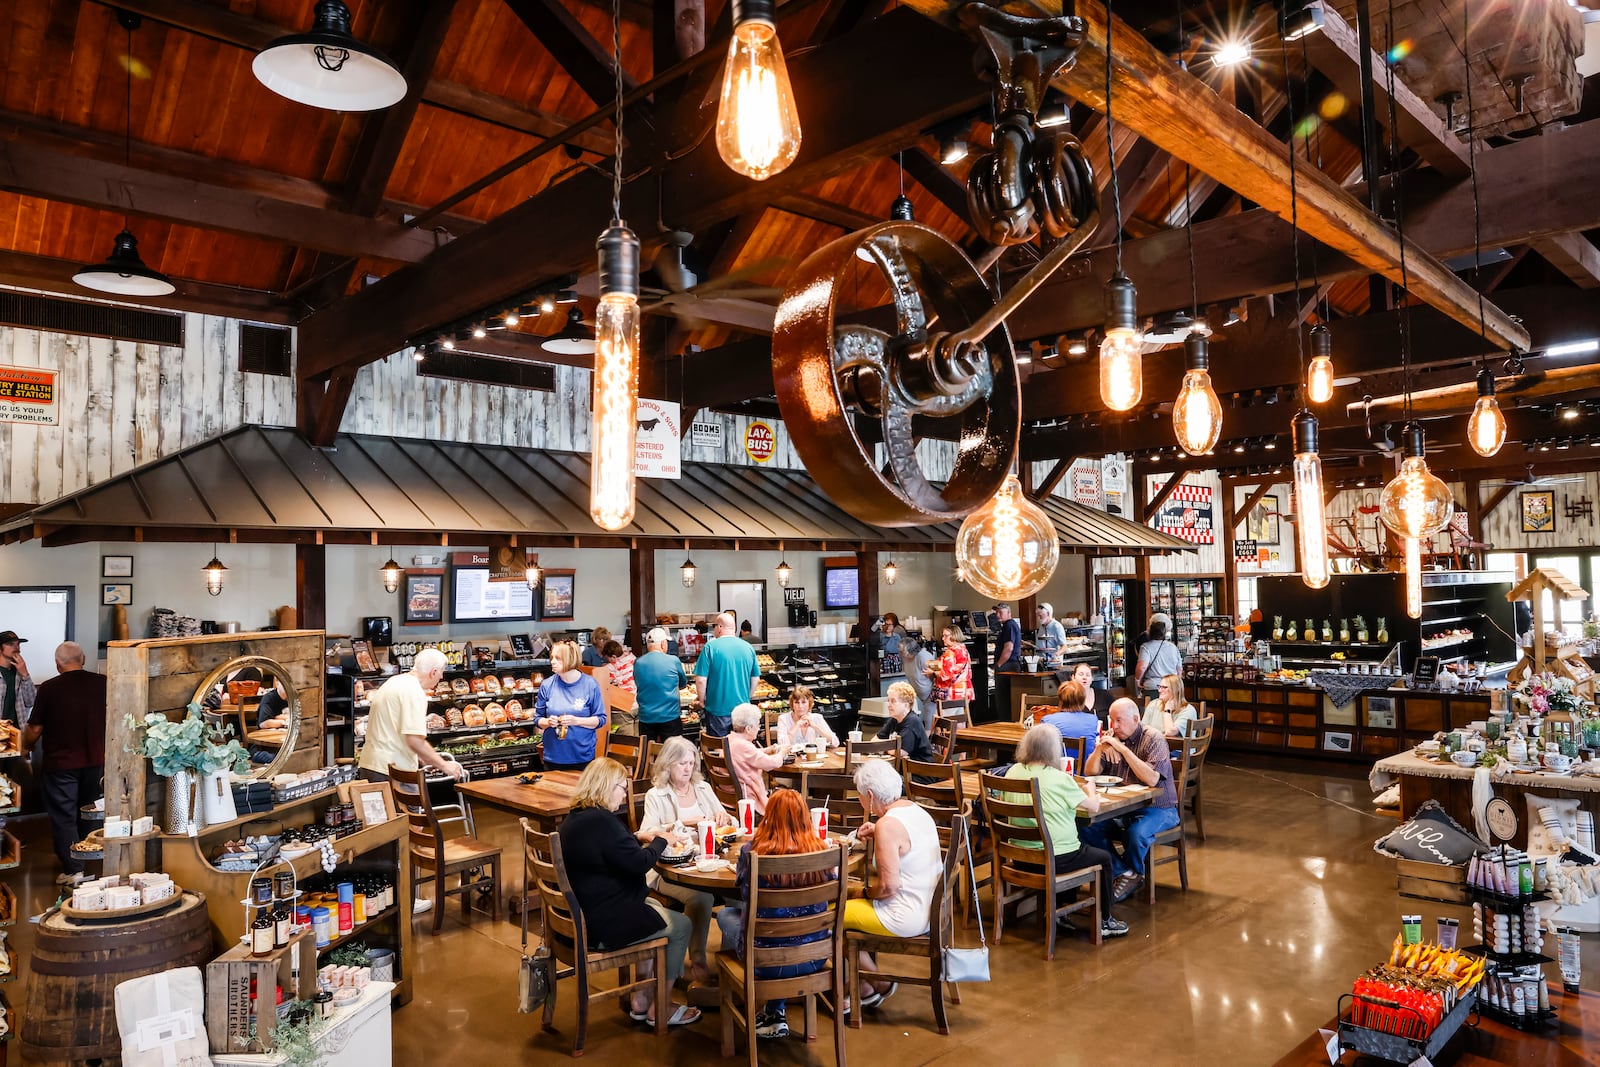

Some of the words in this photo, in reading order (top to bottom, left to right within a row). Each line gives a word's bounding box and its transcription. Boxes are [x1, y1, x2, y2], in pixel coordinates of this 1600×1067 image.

[17, 383, 51, 392] HEALTH
[15, 390, 51, 399] STATION
[12, 414, 53, 422] PROBLEMS
[665, 416, 679, 437] SONS
[693, 423, 720, 434] BOOMS
[748, 428, 766, 438] LAY
[747, 438, 774, 451] BUST
[662, 465, 676, 473] OHIO
[1159, 504, 1185, 528] Purina
[1194, 510, 1210, 533] Eggs
[472, 555, 489, 563] Boar
[784, 589, 805, 600] YIELD
[230, 980, 238, 1037] BROTHERS
[240, 976, 248, 1038] SAUNDERS
